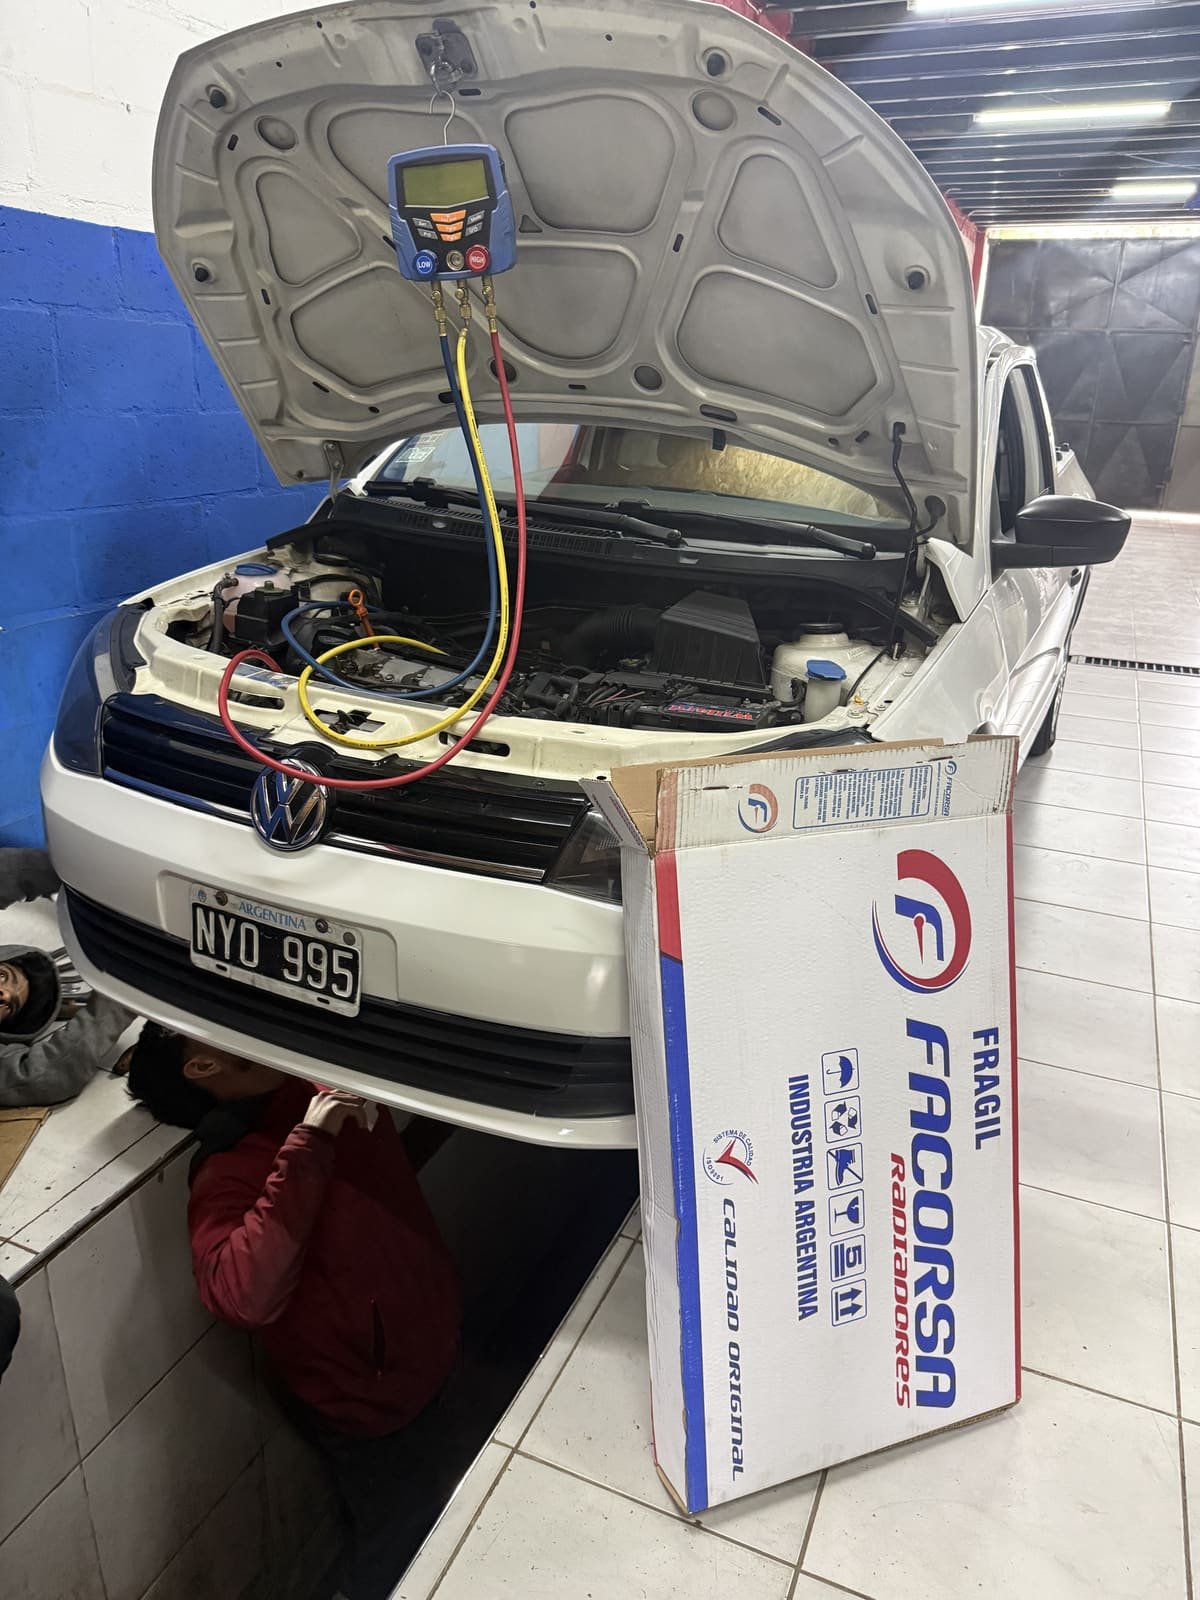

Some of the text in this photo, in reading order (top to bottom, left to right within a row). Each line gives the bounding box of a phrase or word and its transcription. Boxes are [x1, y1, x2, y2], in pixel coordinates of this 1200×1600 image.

[418, 260, 431, 269] LOW
[943, 776, 953, 817] FACORSA
[239, 901, 306, 931] ARGENTINA
[196, 906, 354, 998] NYO 995
[972, 1026, 1001, 1151] FRAGIL
[713, 1129, 754, 1166] SISTEMA DE CALIDAD
[788, 1074, 819, 1321] INDUSTRIA ARGENTINA
[905, 1017, 956, 1409] FACORSA
[846, 1244, 862, 1268] 5
